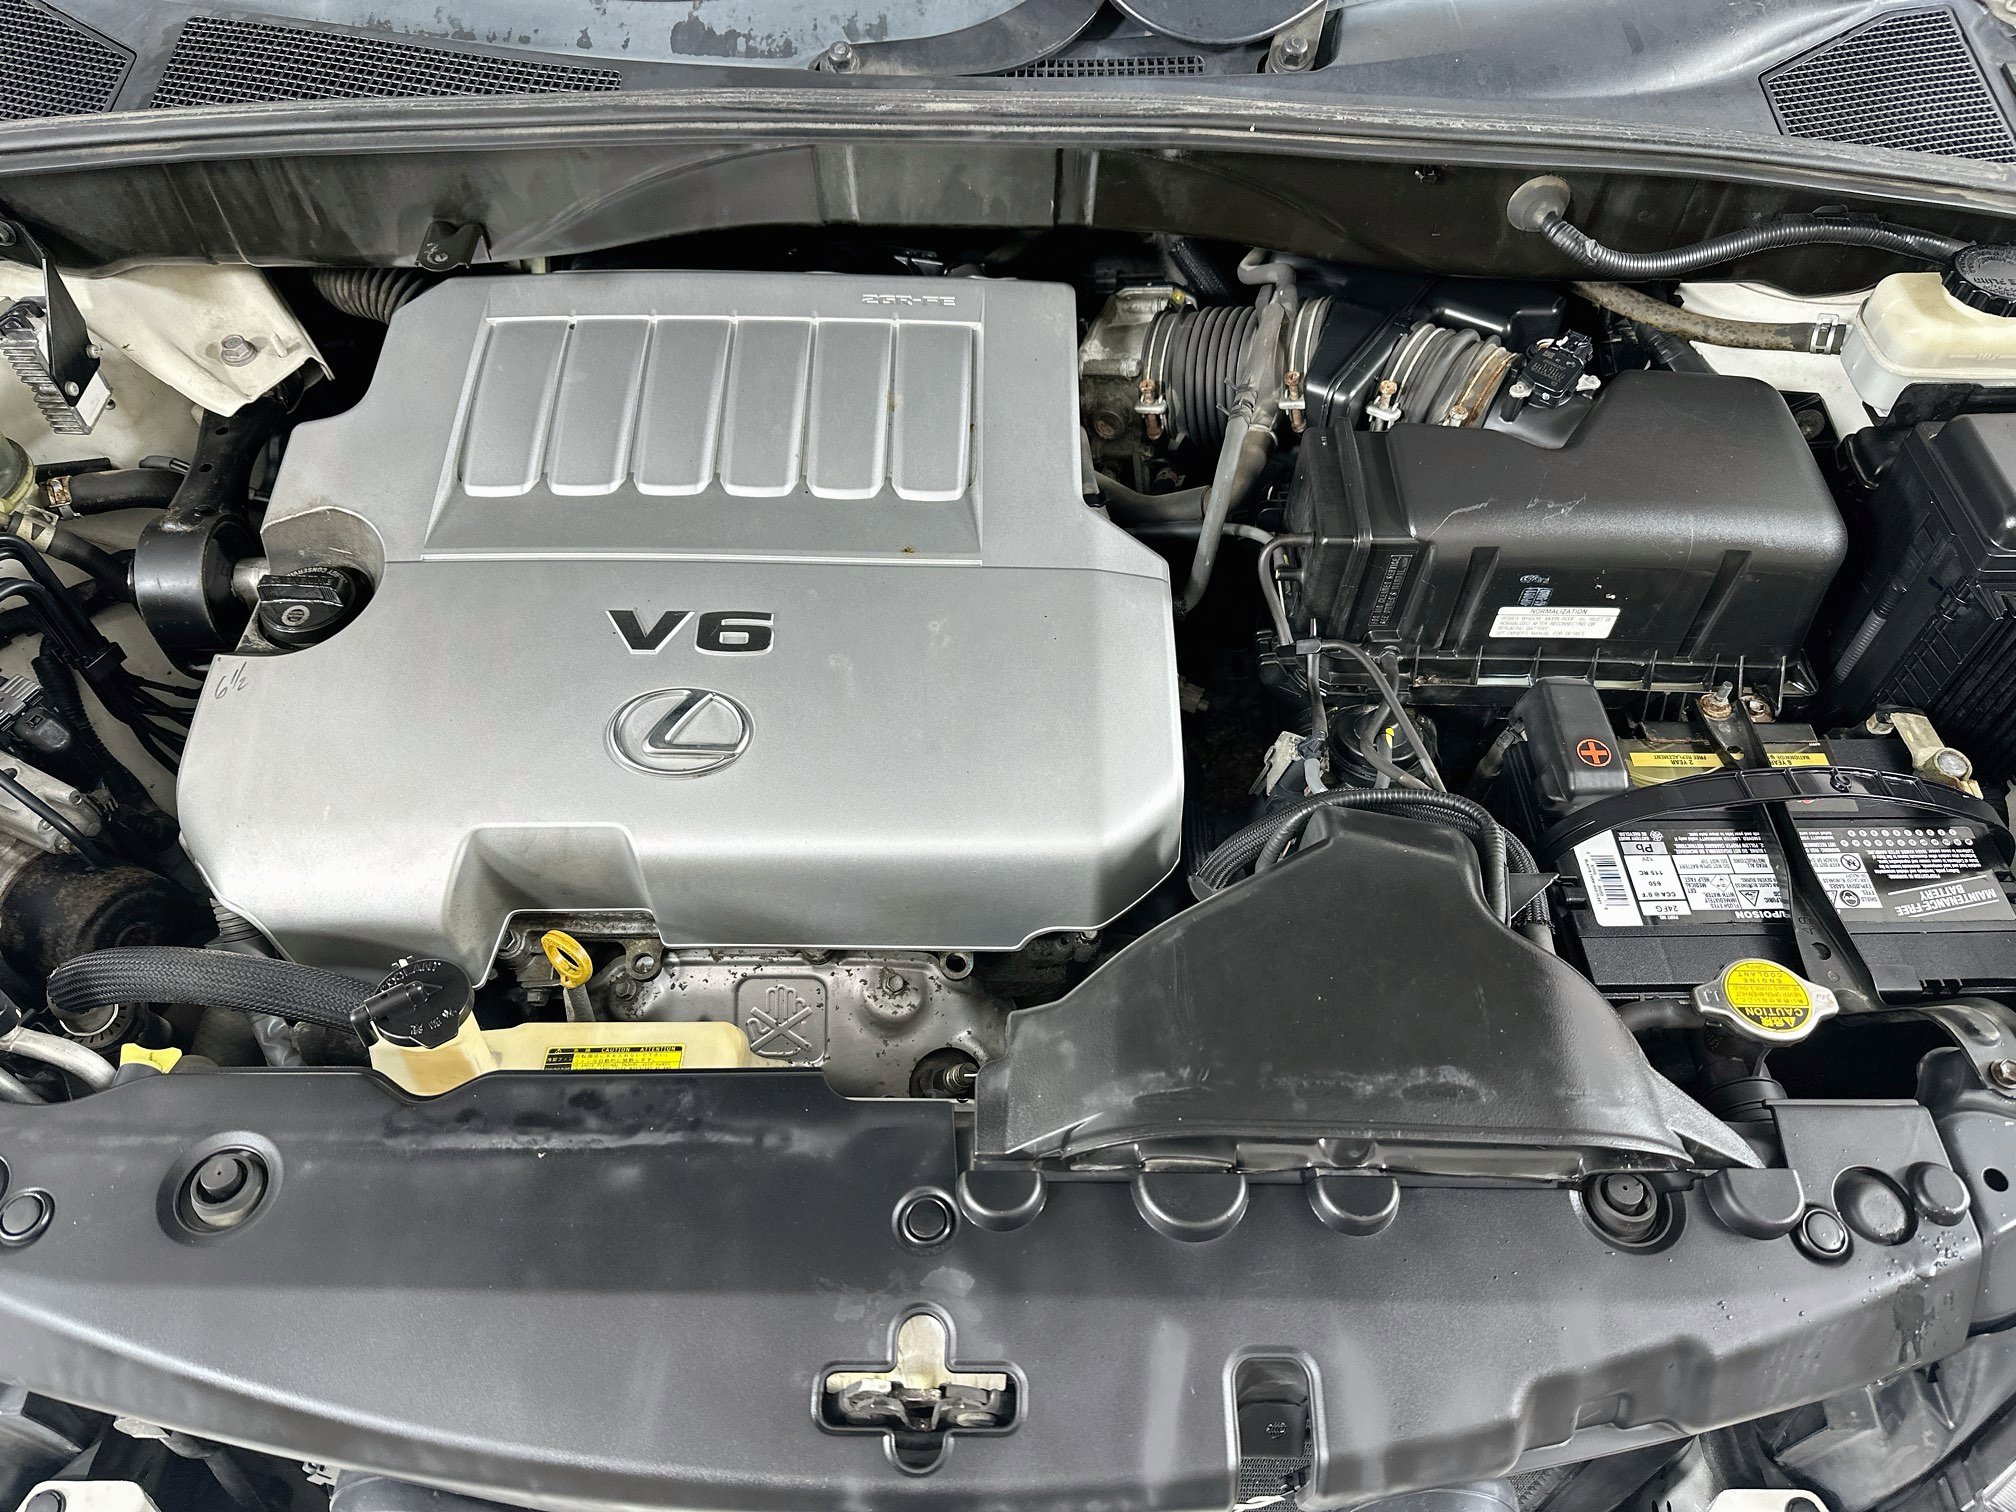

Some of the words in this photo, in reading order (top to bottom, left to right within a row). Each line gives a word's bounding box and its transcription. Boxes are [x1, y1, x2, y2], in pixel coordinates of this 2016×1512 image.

[605, 610, 775, 656] V6
[1635, 843, 1654, 853] Pb
[1919, 883, 1966, 900] BATTERY
[1894, 887, 1998, 917] MAINTENANCE-FREE
[1744, 1007, 1804, 1017] CAUTION
